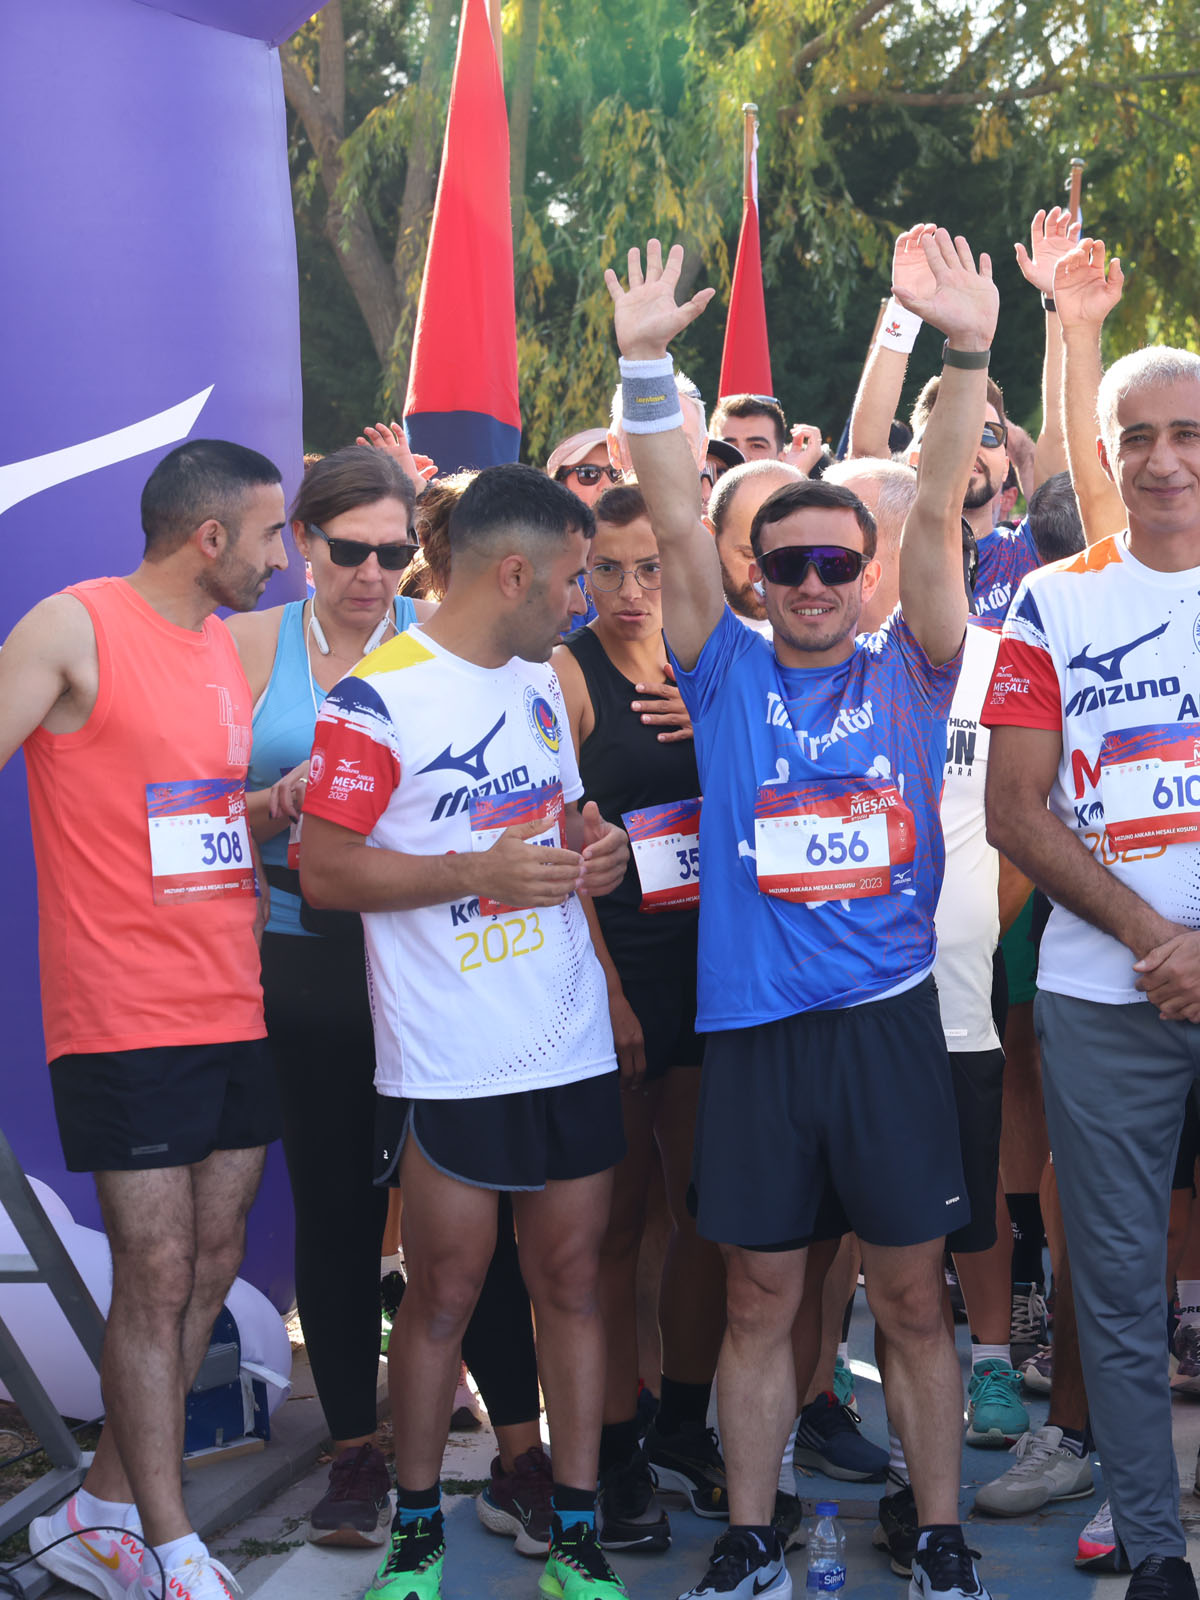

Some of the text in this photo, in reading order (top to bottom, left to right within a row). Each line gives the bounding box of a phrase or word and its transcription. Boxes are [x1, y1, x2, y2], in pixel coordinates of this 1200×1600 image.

[993, 682, 1029, 694] MEŞALE
[949, 718, 977, 730] HLON
[946, 729, 977, 766] UN
[947, 765, 972, 776] ARA
[332, 776, 375, 792] MEŞALE
[328, 791, 348, 801] 2023
[850, 795, 898, 816] MEŞALE
[1134, 831, 1155, 839] ANKARA
[200, 831, 243, 866] 308
[806, 830, 870, 866] 656
[676, 847, 700, 880] 35
[860, 877, 883, 890] 2023
[456, 912, 545, 972] 2023
